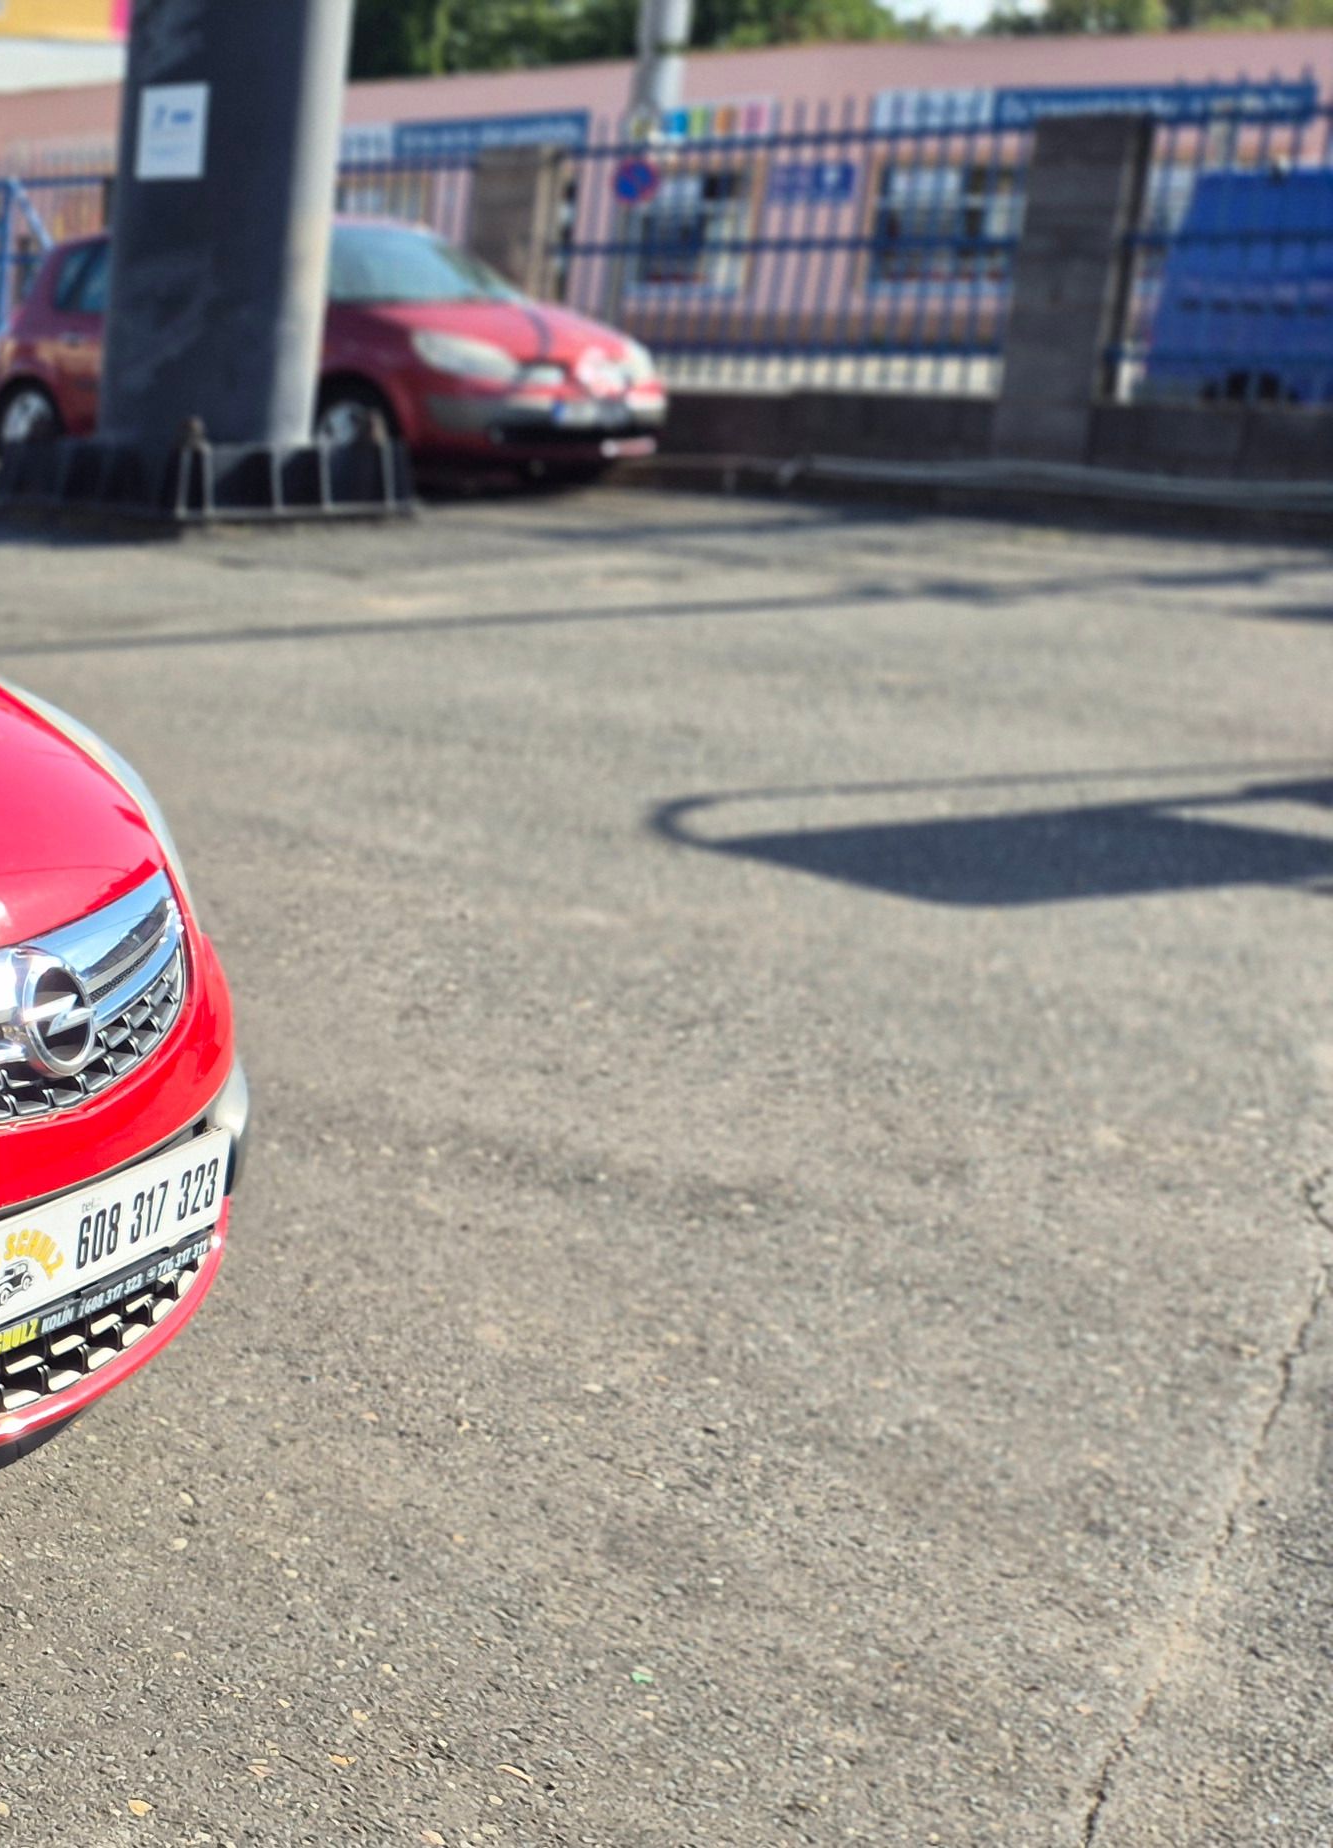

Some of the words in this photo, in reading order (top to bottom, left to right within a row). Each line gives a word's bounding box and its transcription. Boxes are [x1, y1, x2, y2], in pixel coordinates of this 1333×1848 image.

[76, 1202, 121, 1269] 608
[130, 1180, 169, 1244] 317
[177, 1158, 219, 1221] 323
[4, 1228, 65, 1280] SCHULZ
[41, 1305, 75, 1334] KOLÍN
[105, 1283, 124, 1304] 317
[124, 1273, 143, 1294] 323
